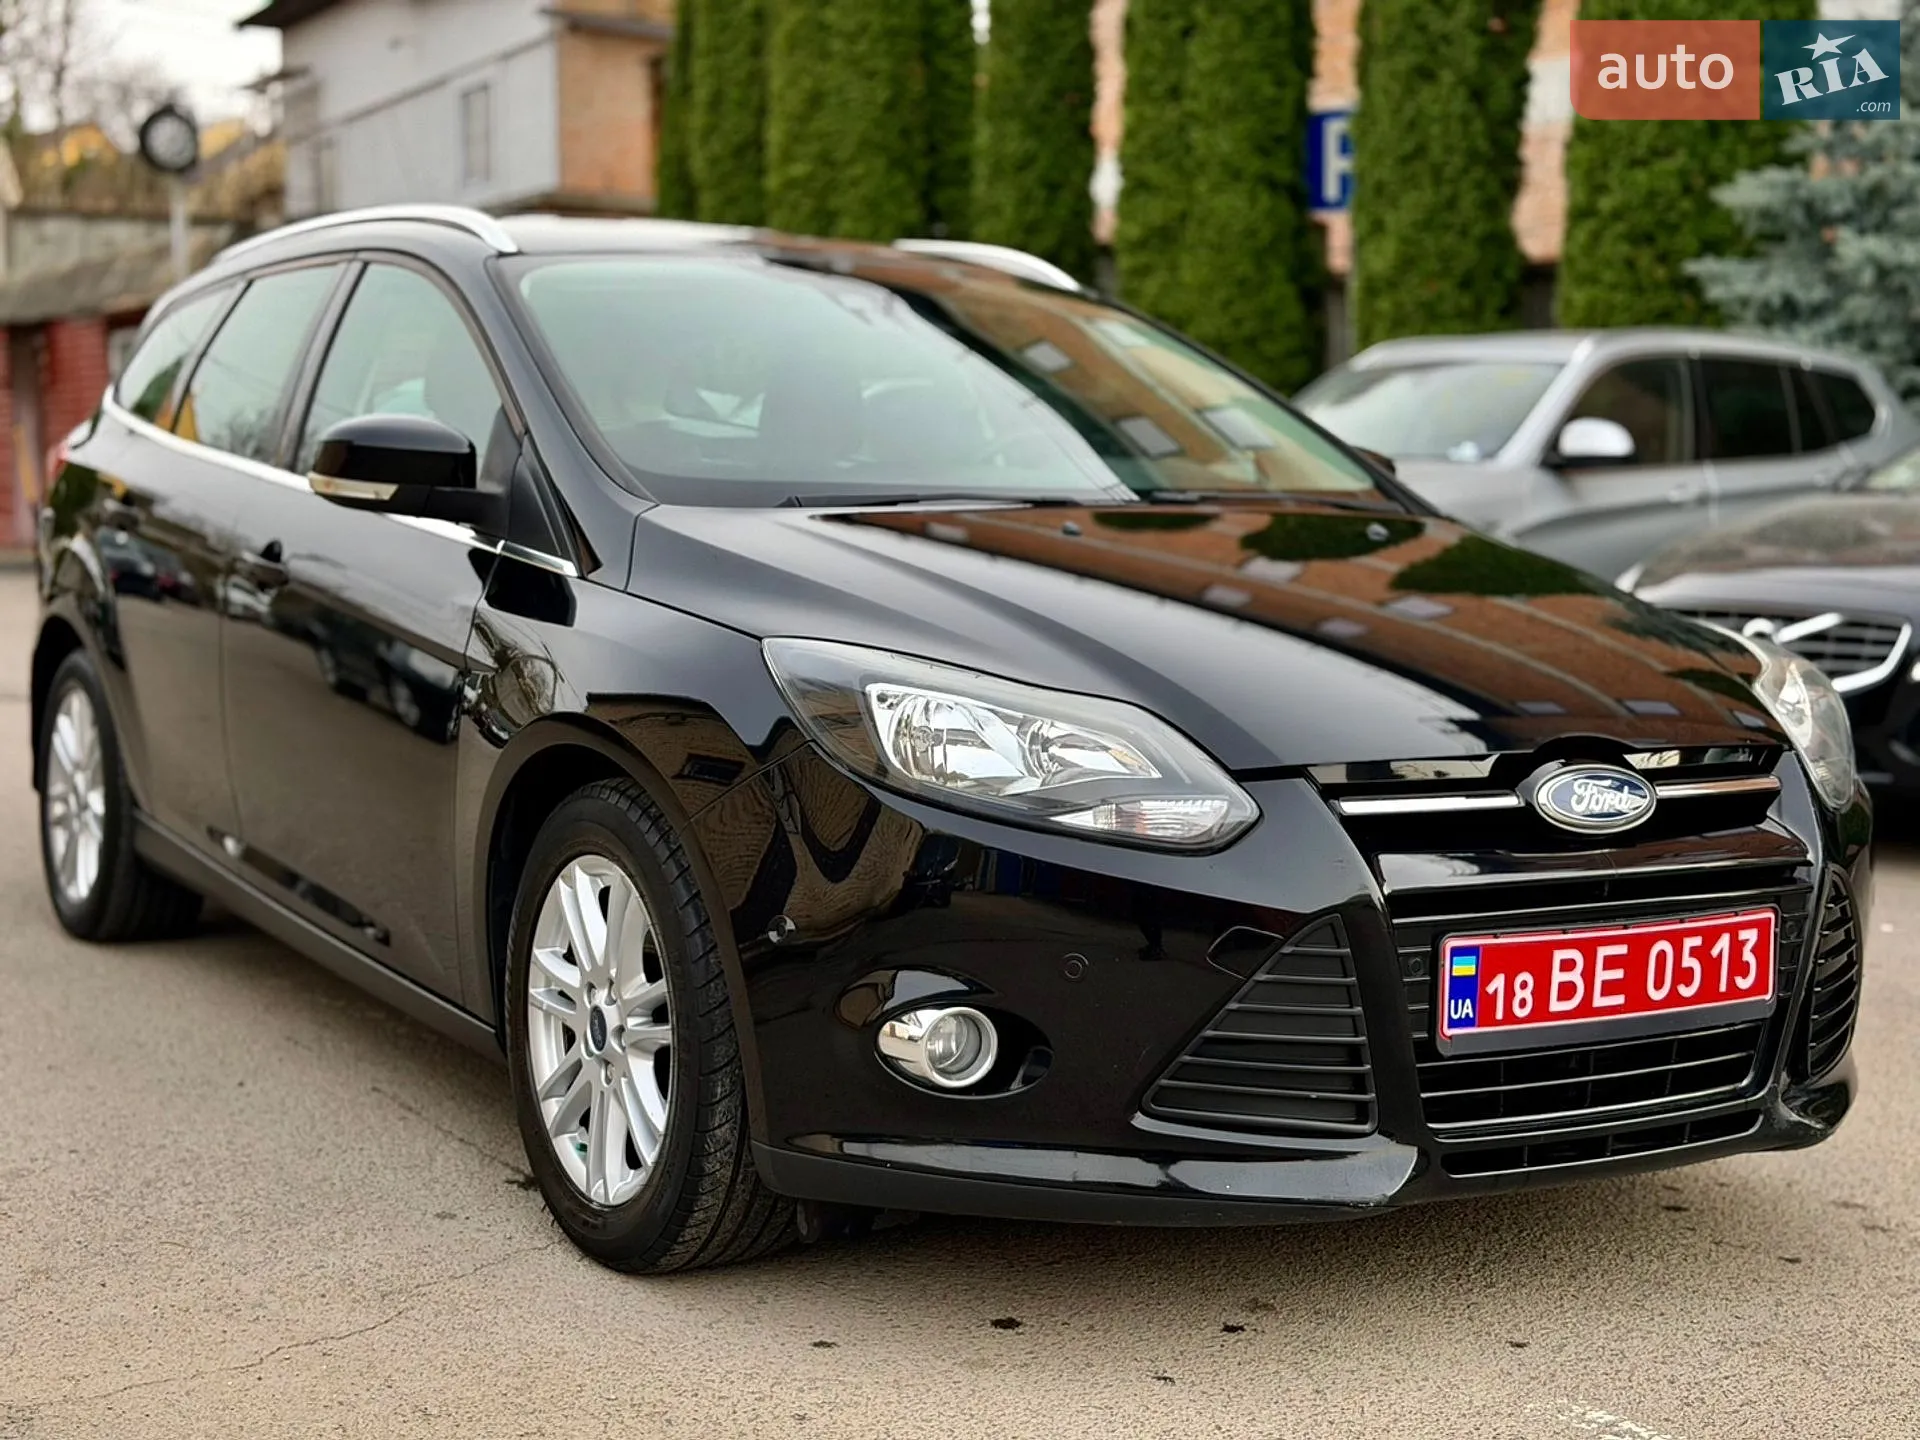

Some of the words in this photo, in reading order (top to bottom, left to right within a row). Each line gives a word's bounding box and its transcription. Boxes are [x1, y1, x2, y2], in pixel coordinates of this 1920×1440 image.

[1571, 778, 1630, 812] Ford
[1486, 972, 1535, 1020] 18
[1549, 944, 1629, 1012] BE
[1646, 928, 1759, 1001] 0513
[1450, 998, 1474, 1019] UA
